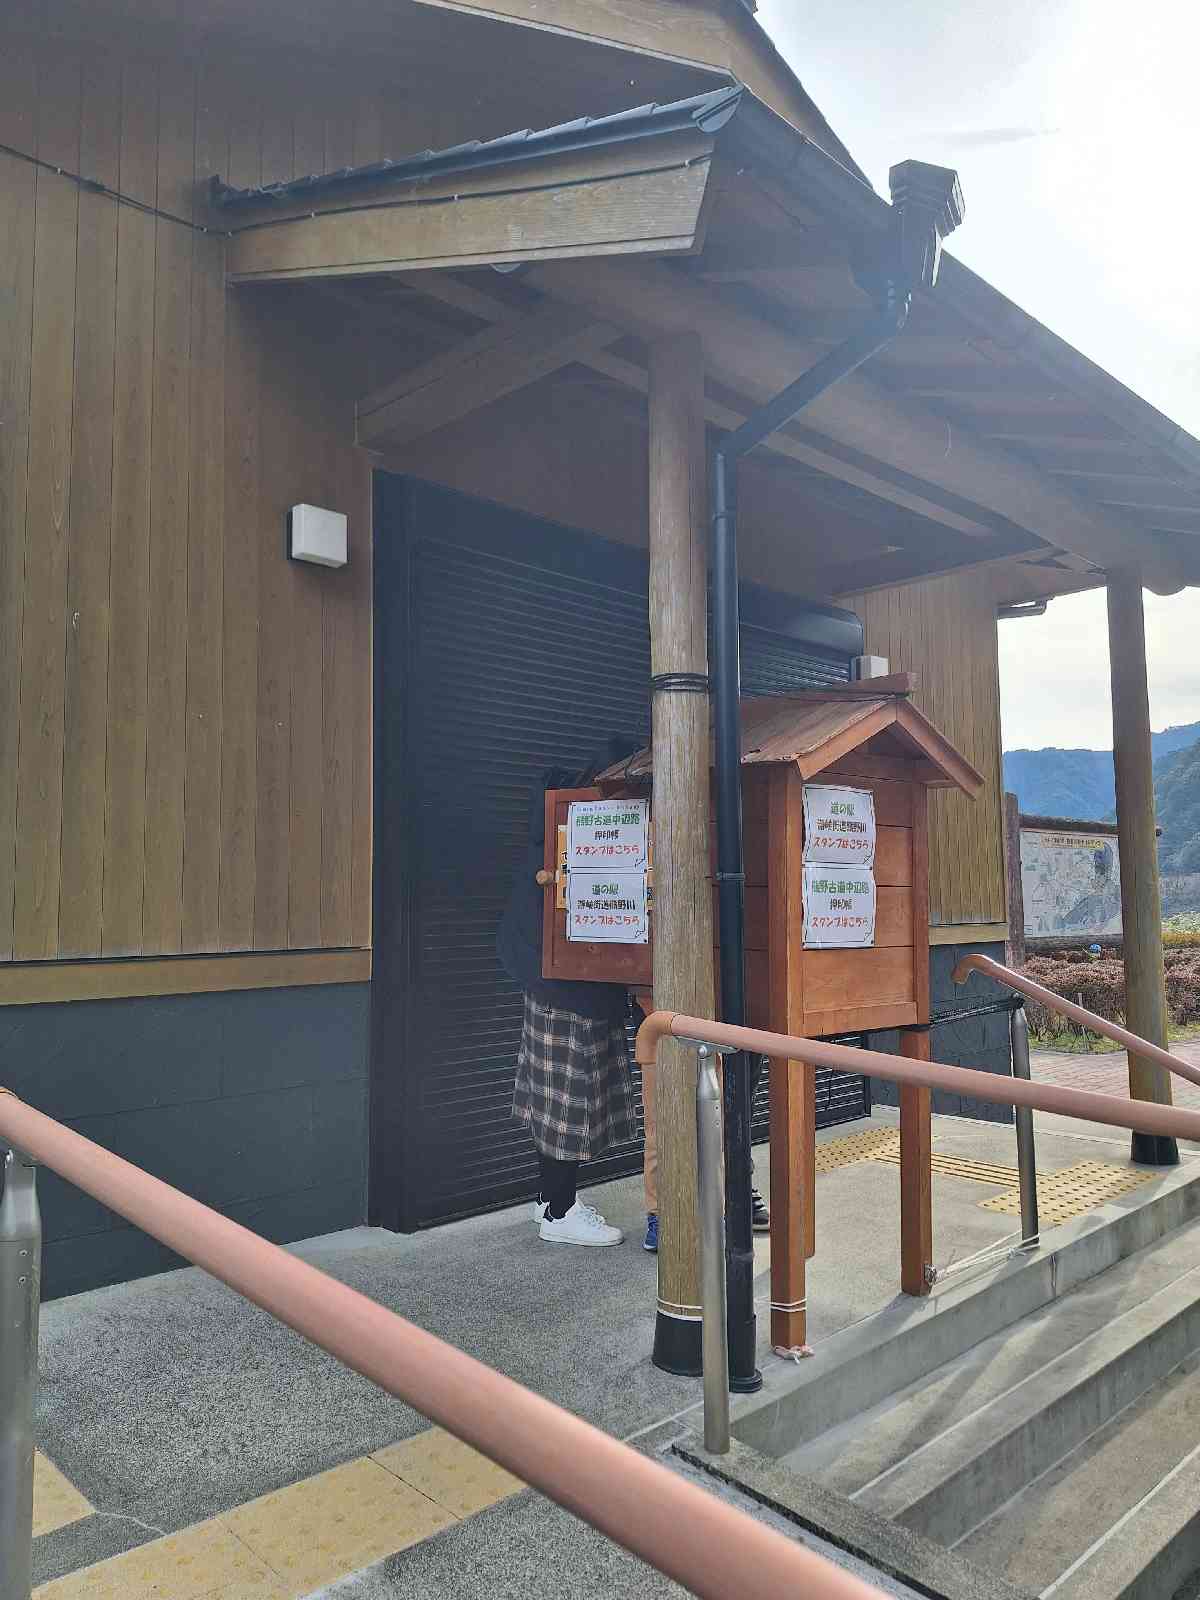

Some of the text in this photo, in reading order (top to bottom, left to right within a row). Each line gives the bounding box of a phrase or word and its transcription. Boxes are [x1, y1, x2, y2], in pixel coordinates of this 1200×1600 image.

[814, 837, 869, 849] スタンプはこちら
[576, 844, 640, 856] スタンプはこちら
[575, 915, 640, 926] スタンプはこちら
[811, 916, 868, 928] スタンプはこちら
